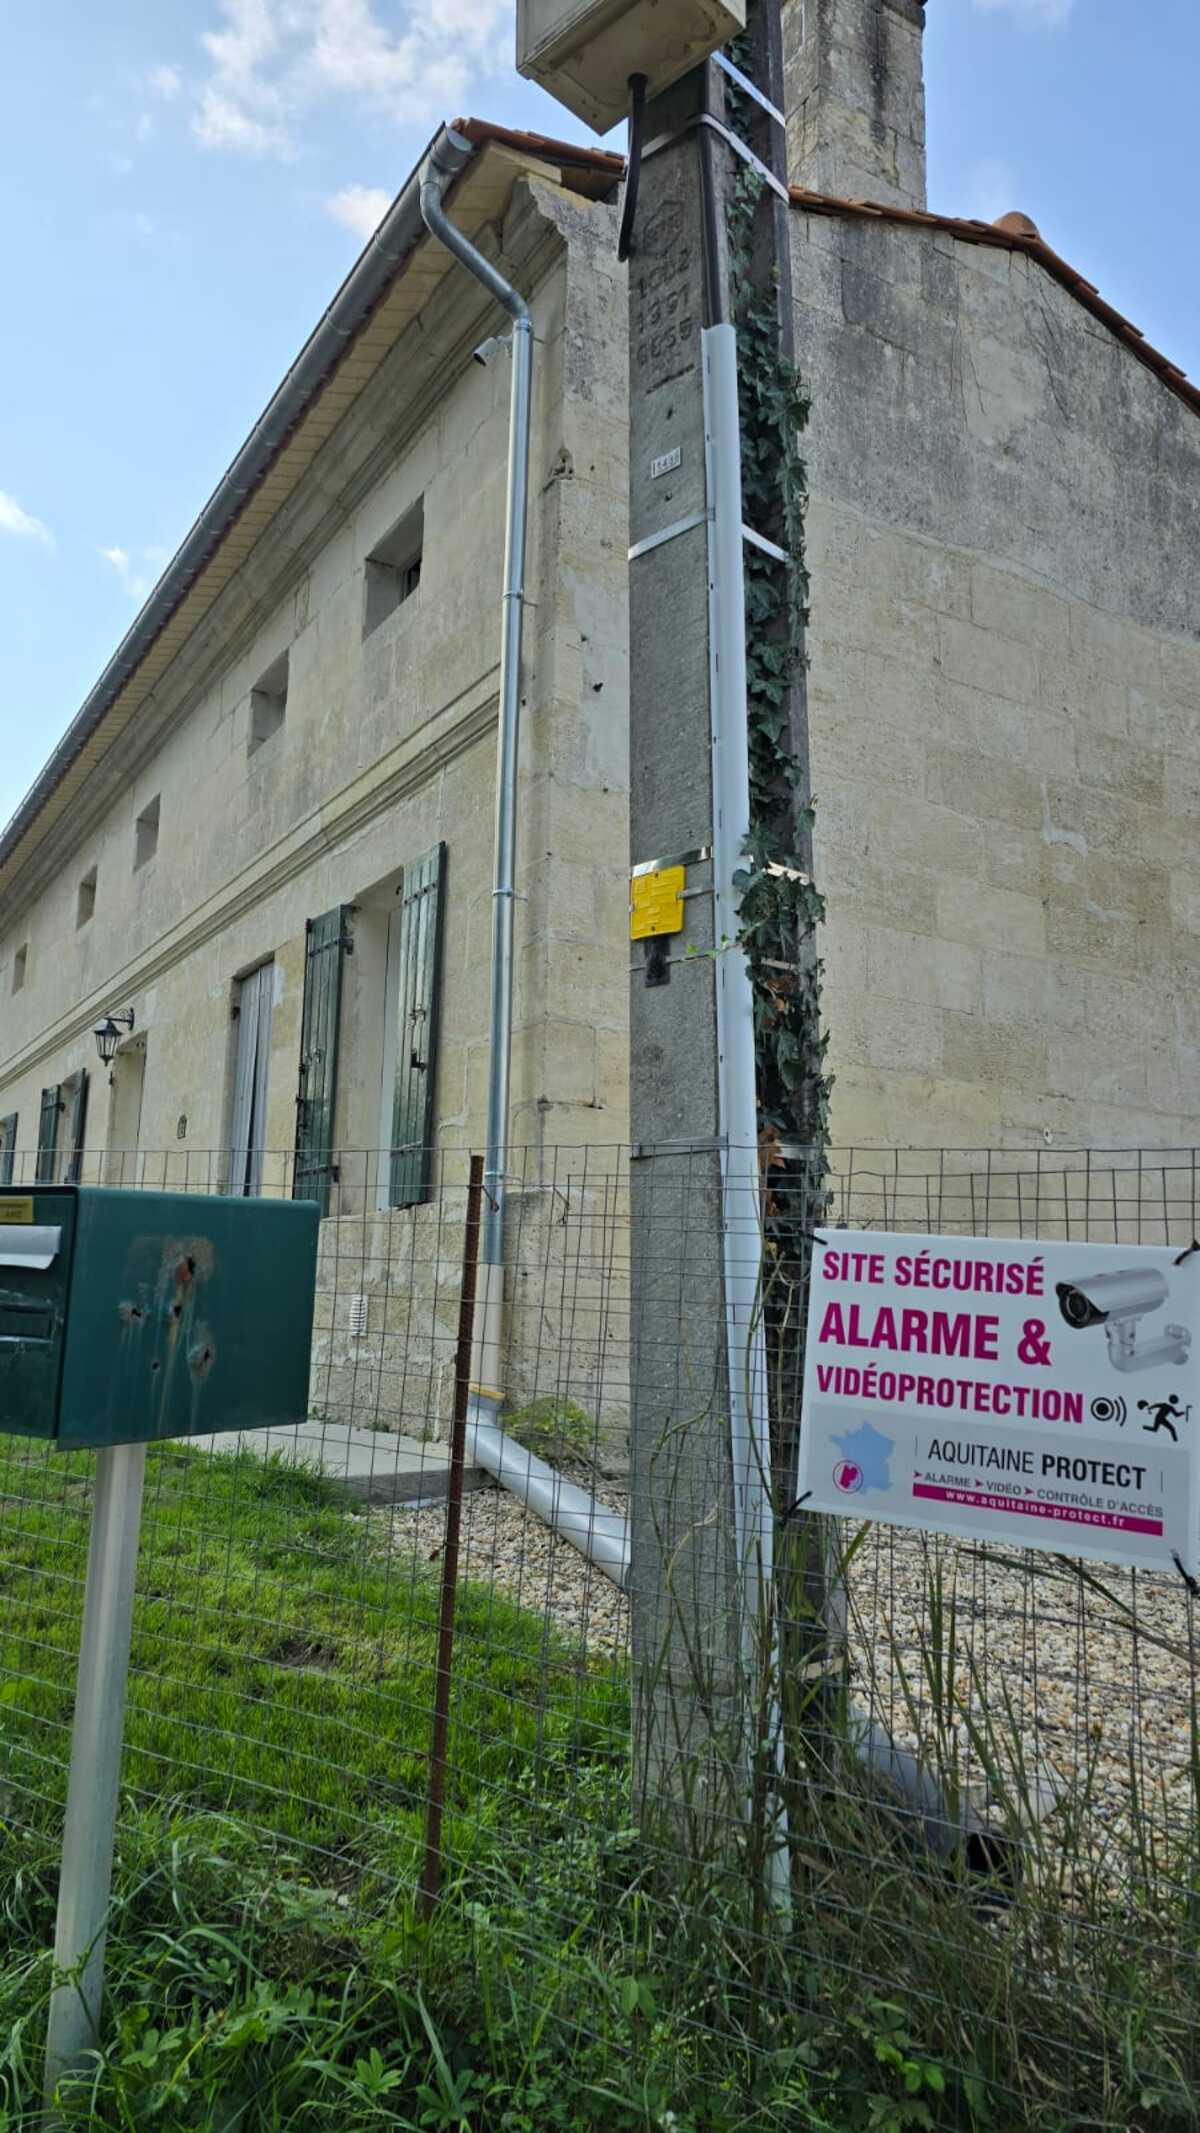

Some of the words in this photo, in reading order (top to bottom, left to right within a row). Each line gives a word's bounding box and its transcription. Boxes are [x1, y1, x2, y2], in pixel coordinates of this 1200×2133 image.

[822, 1250, 885, 1284] SITE
[893, 1250, 1044, 1297] SÉCURISÉ
[818, 1301, 1000, 1361] ALARME
[1017, 1318, 1052, 1366] &
[816, 1362, 1084, 1424] VIDÉOPROTECTION
[928, 1439, 1034, 1474] AQUITAINE
[1042, 1453, 1147, 1491] PROTECT
[925, 1471, 971, 1488] ALARME
[986, 1479, 1022, 1496] VIDÉO
[1036, 1488, 1105, 1509] CONTRÔLE
[1107, 1498, 1164, 1518] D'ACCÈS
[945, 1490, 1125, 1527] www.aquitaine-protect.fr
